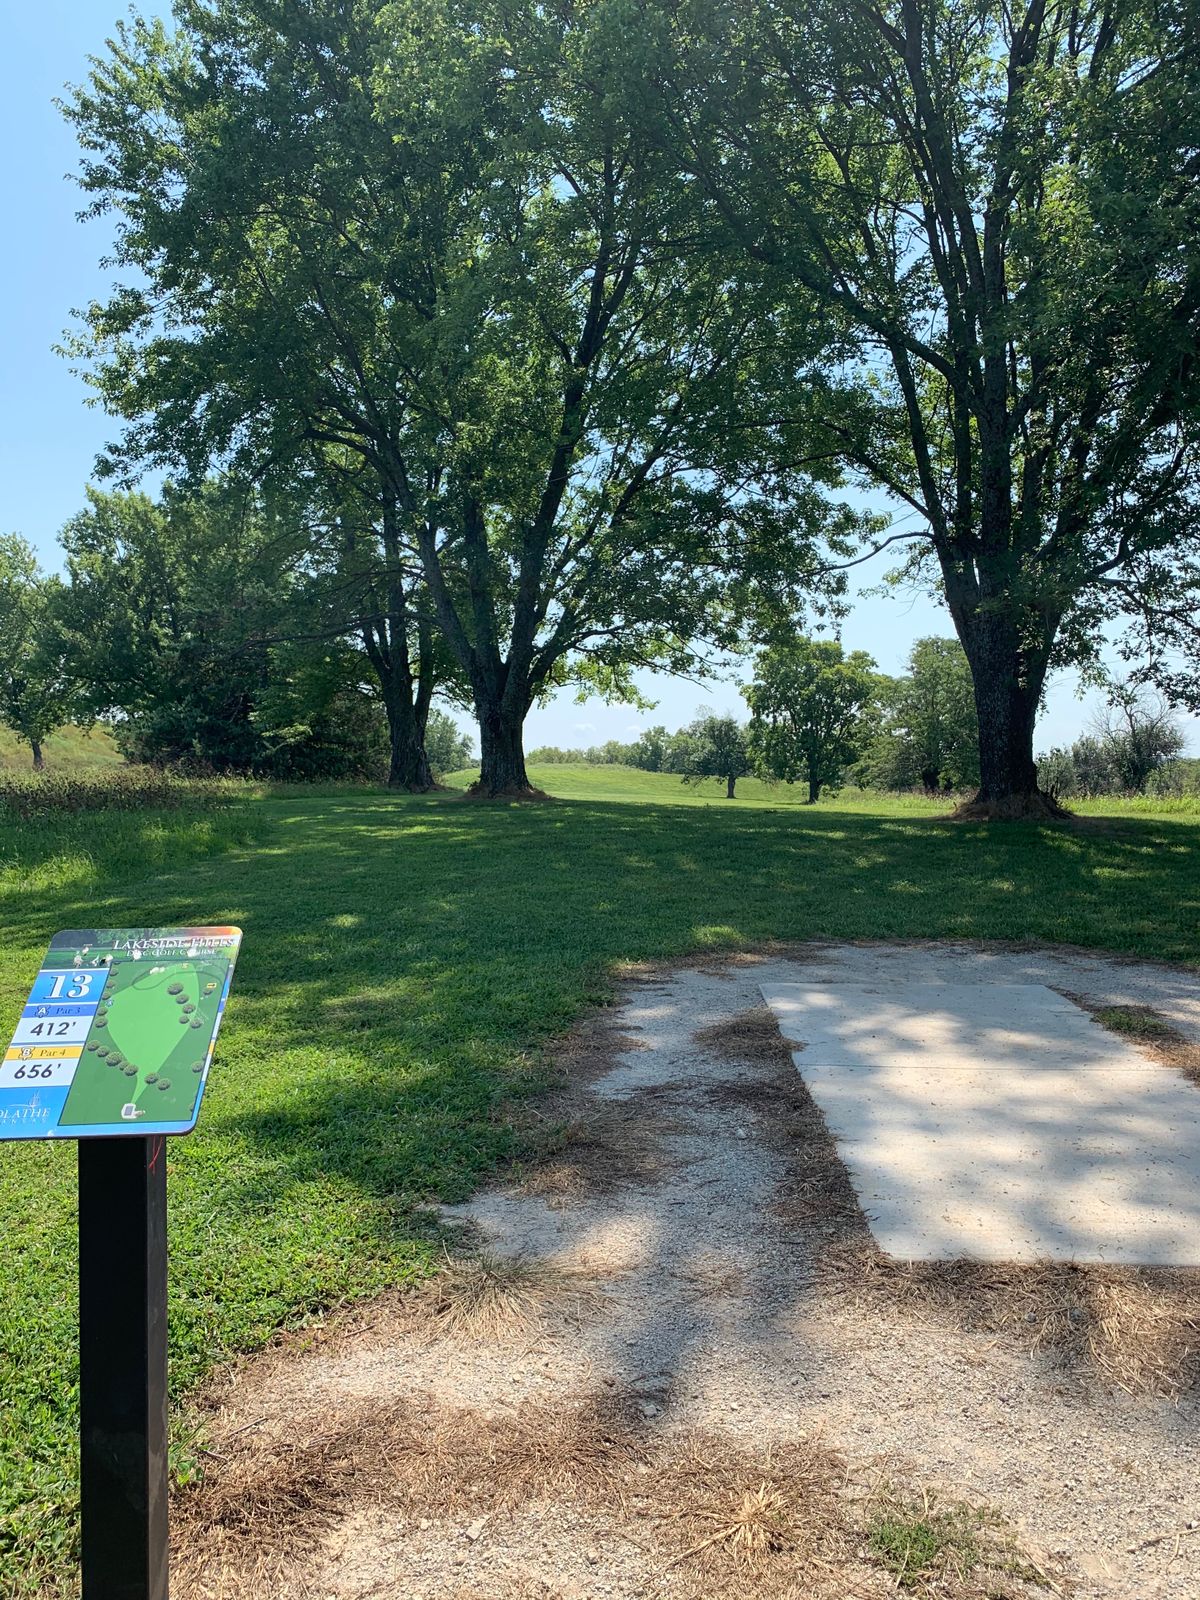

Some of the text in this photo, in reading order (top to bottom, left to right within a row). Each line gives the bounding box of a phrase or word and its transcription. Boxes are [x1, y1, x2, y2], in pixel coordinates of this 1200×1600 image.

[113, 937, 234, 950] LAKESIDE HILLS
[126, 949, 147, 957] DC
[180, 948, 217, 956] CURSE
[43, 974, 93, 999] 13
[56, 1007, 70, 1015] Par
[30, 1021, 77, 1036] 412'
[40, 1049, 56, 1057] Par
[59, 1048, 66, 1056] 4
[14, 1063, 62, 1079] 656'
